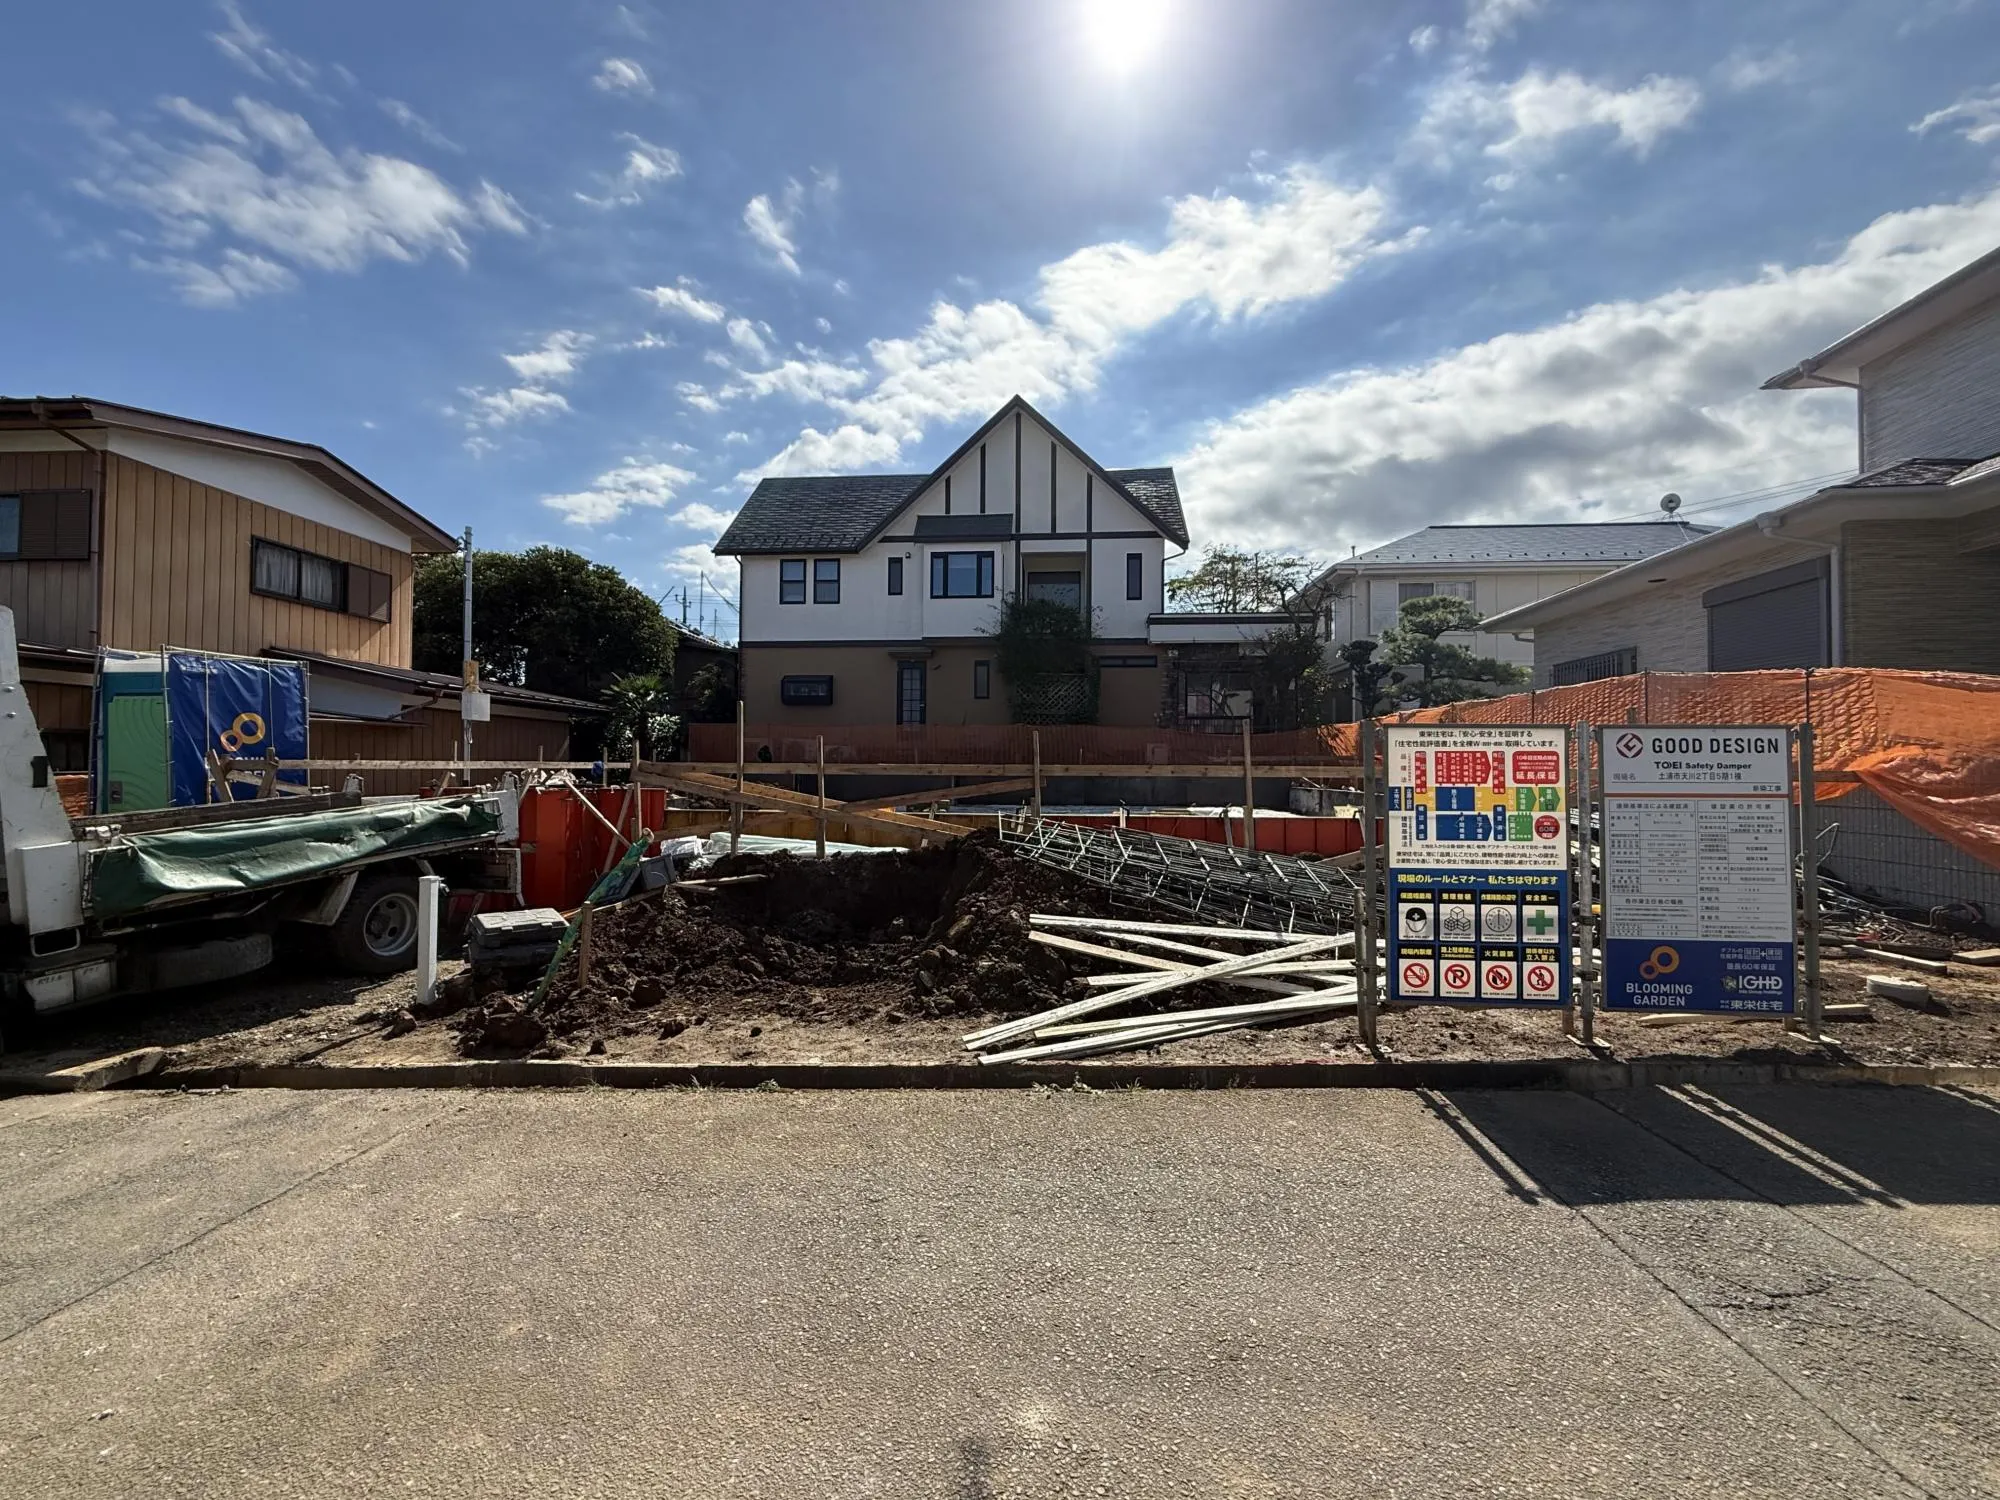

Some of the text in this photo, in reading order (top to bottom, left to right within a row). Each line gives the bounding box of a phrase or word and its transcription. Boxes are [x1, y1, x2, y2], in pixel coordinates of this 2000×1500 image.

[1652, 737, 1779, 755] GOOD DESIGN
[1685, 762, 1714, 770] Safety
[1717, 762, 1752, 771] Damper
[1397, 874, 1559, 885] 現場のルールとマナー 私たちは守ります
[1525, 894, 1556, 902] 安全第一
[1625, 983, 1693, 995] BLOOMING
[1633, 995, 1685, 1006] GARDEN
[1730, 1000, 1783, 1010] 東栄住宅
